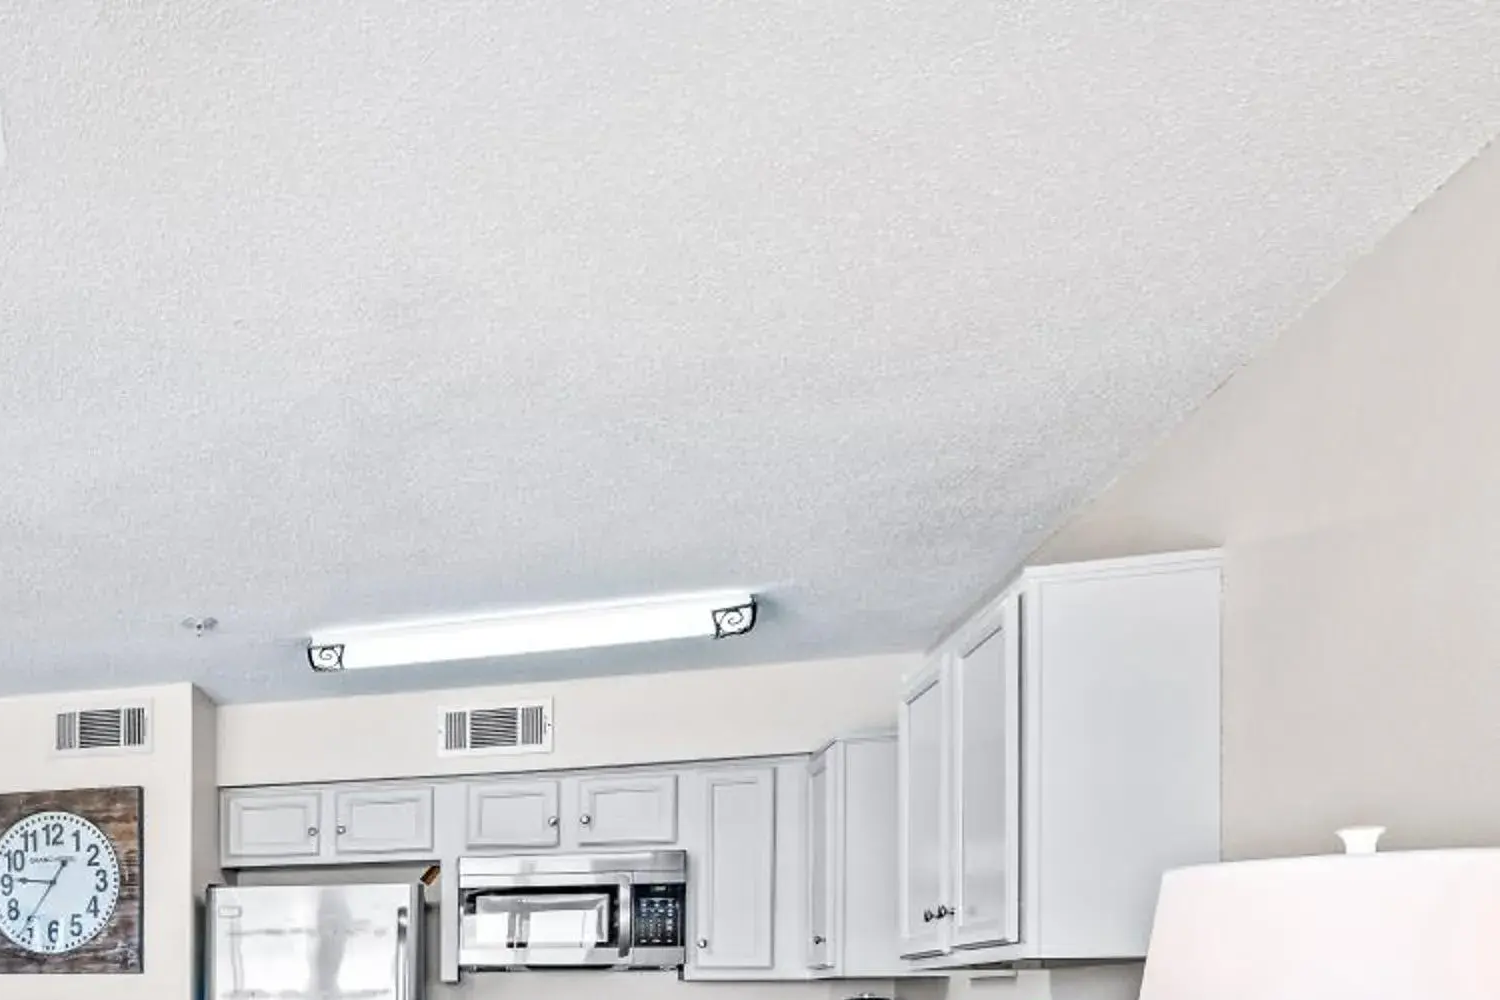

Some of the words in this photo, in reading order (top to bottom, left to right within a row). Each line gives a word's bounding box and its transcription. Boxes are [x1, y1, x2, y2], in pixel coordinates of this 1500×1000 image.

[20, 830, 38, 853] 11
[42, 823, 65, 846] 12
[72, 830, 81, 852] 1
[5, 849, 25, 872] 10
[87, 844, 100, 867] 2
[0, 874, 14, 897] 9
[95, 869, 109, 893] 3
[7, 898, 20, 921] 8
[86, 895, 100, 918] 4
[47, 919, 60, 943] 6
[70, 913, 83, 937] 5
